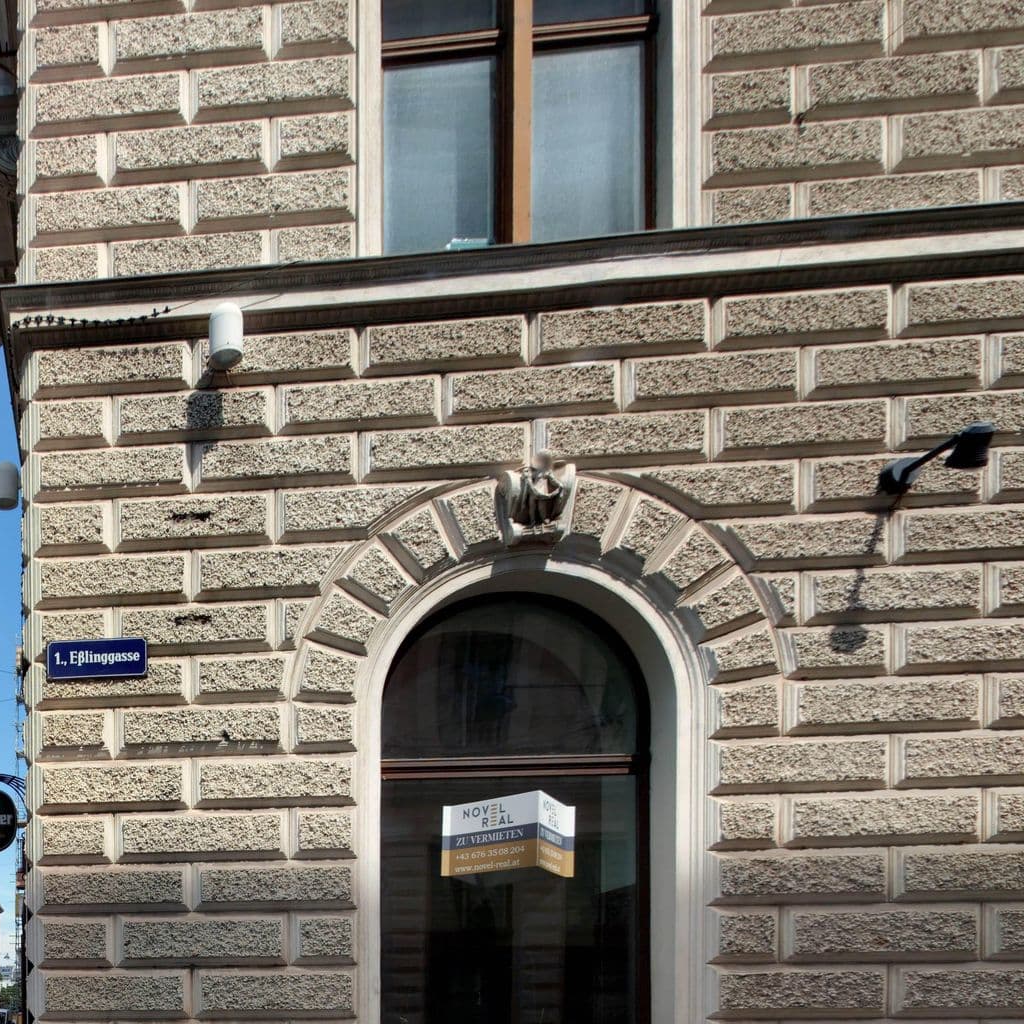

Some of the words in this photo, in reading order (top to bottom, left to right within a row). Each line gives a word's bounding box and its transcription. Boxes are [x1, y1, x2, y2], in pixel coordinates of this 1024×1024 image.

[54, 652, 67, 666] 1.,
[69, 650, 140, 666] Eßlinggasse
[463, 803, 506, 819] NOVEL
[481, 814, 514, 828] REAL
[456, 836, 469, 847] ZU
[471, 828, 524, 844] VERMIETEN
[471, 849, 486, 859] 676
[455, 859, 520, 873] www.novel-real.at
